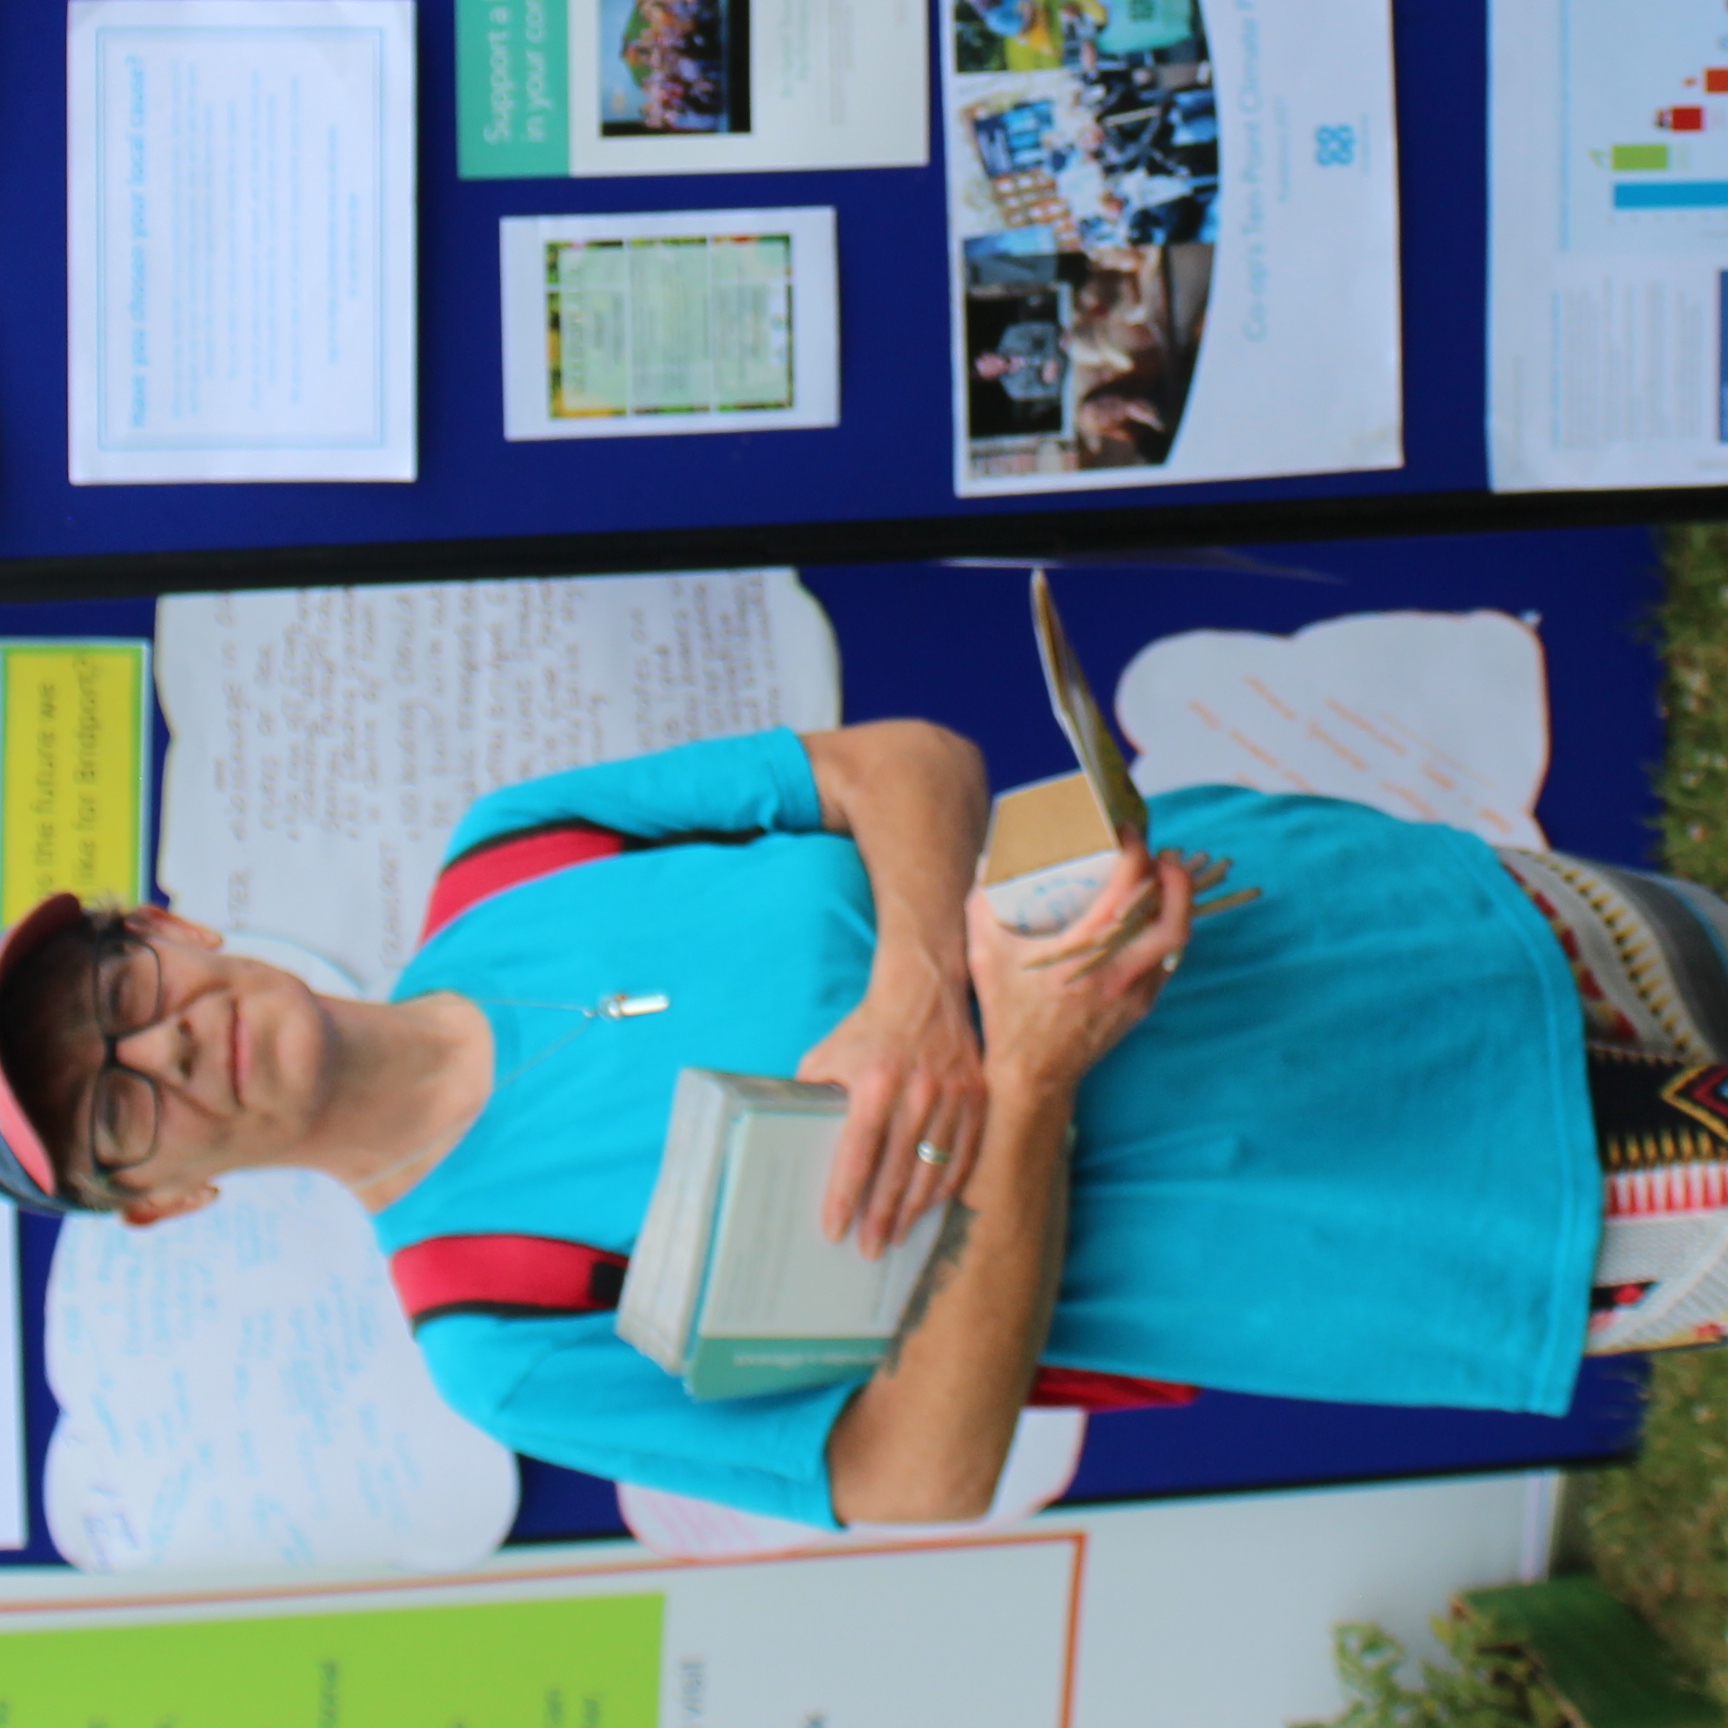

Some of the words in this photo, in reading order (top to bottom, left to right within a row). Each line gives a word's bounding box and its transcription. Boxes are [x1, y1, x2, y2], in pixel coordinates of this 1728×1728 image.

[483, 31, 515, 143] Support
[529, 50, 553, 110] your
[528, 115, 547, 143] in
